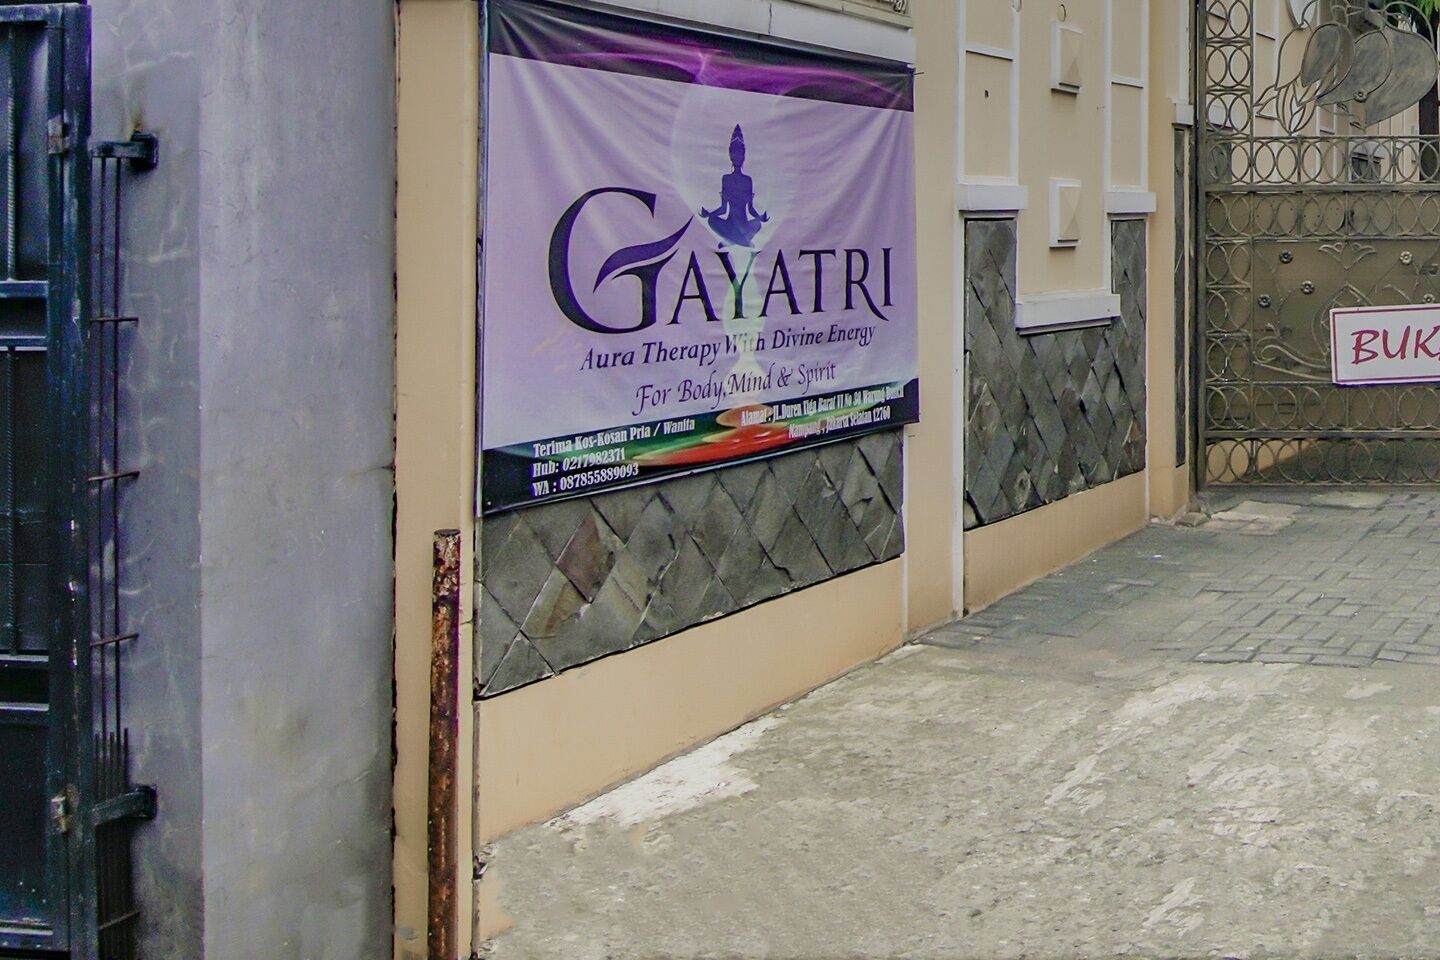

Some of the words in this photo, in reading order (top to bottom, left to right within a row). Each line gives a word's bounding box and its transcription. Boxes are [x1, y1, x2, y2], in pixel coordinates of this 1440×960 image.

[548, 187, 895, 334] GAYATRI
[580, 347, 634, 370] Aura
[642, 341, 721, 366] Therapy
[726, 333, 765, 353] With
[772, 328, 823, 350] Divine
[827, 324, 876, 346] Energy
[632, 385, 671, 416] For
[777, 366, 793, 387] &
[798, 361, 836, 394] Spirit
[873, 405, 891, 421] 12760
[533, 439, 572, 458] Terima
[575, 430, 627, 450] Kos-Kosan
[630, 425, 651, 439] Pria
[653, 423, 660, 436] /
[663, 419, 695, 434] Wanita
[533, 460, 559, 477] Hub:
